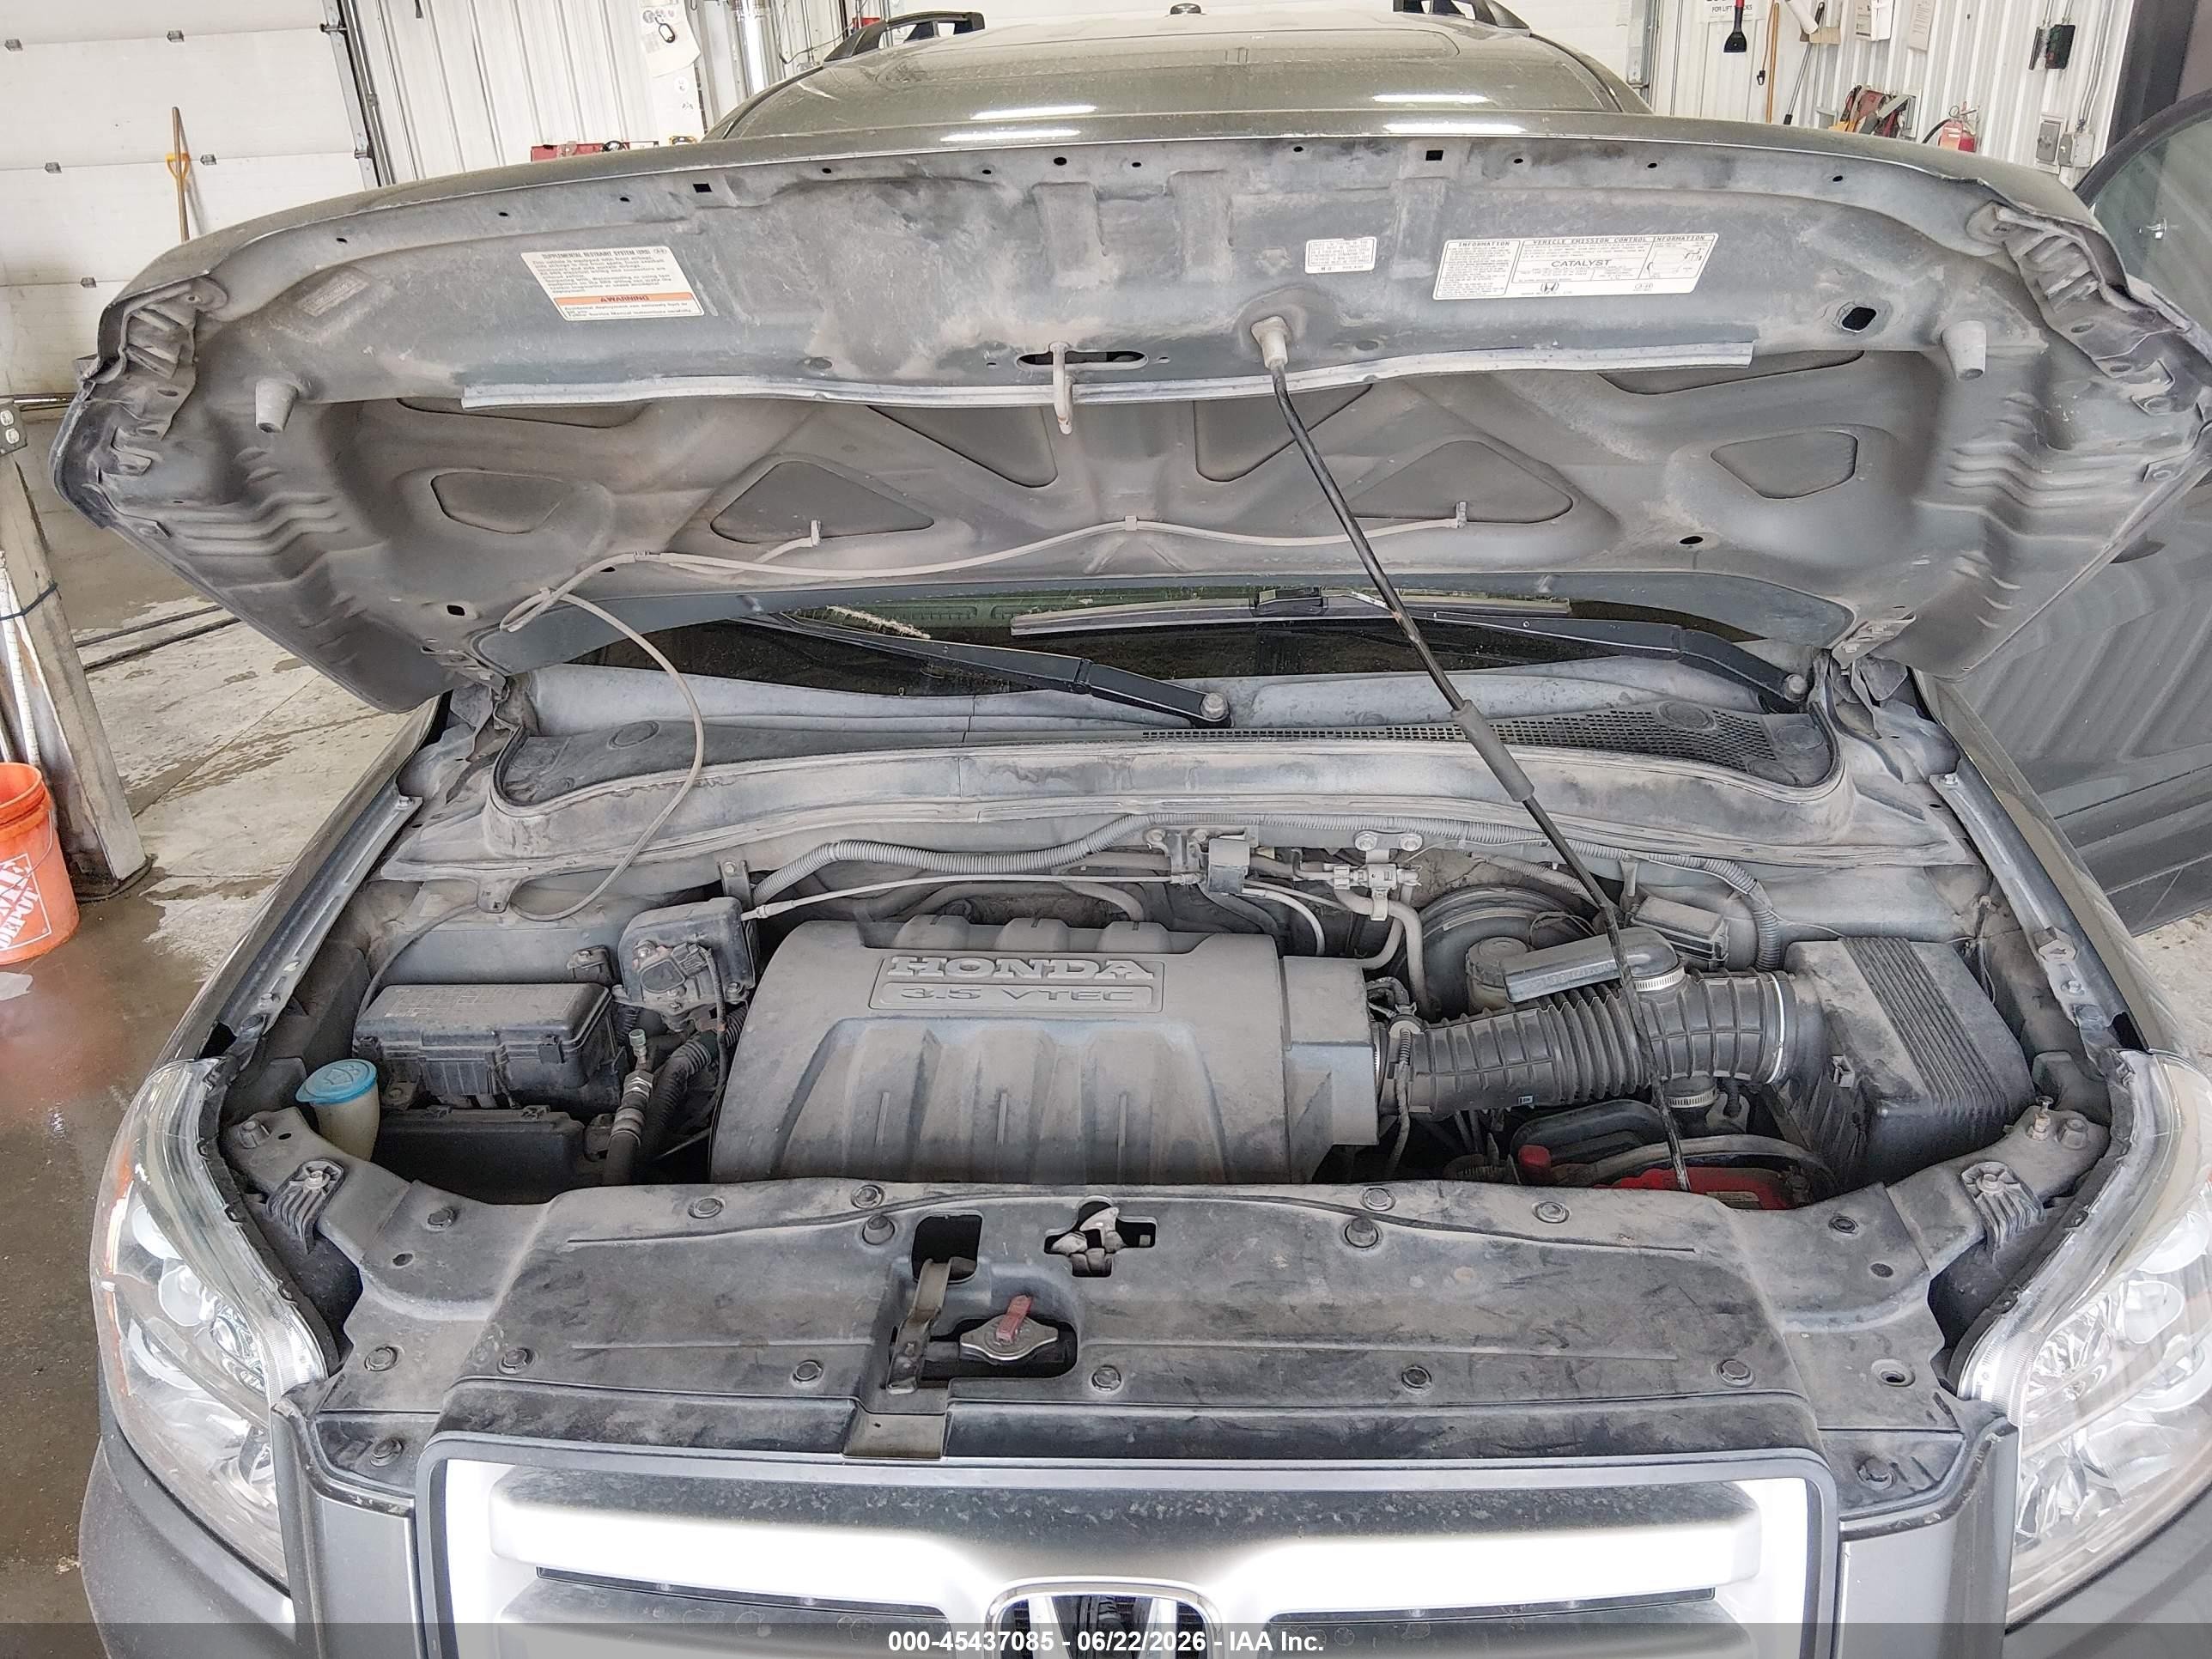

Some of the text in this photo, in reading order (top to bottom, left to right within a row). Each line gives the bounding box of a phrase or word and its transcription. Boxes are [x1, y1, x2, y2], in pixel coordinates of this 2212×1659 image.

[888, 956, 1155, 980] HONDA
[901, 988, 1134, 1001] 3.5 VTEC
